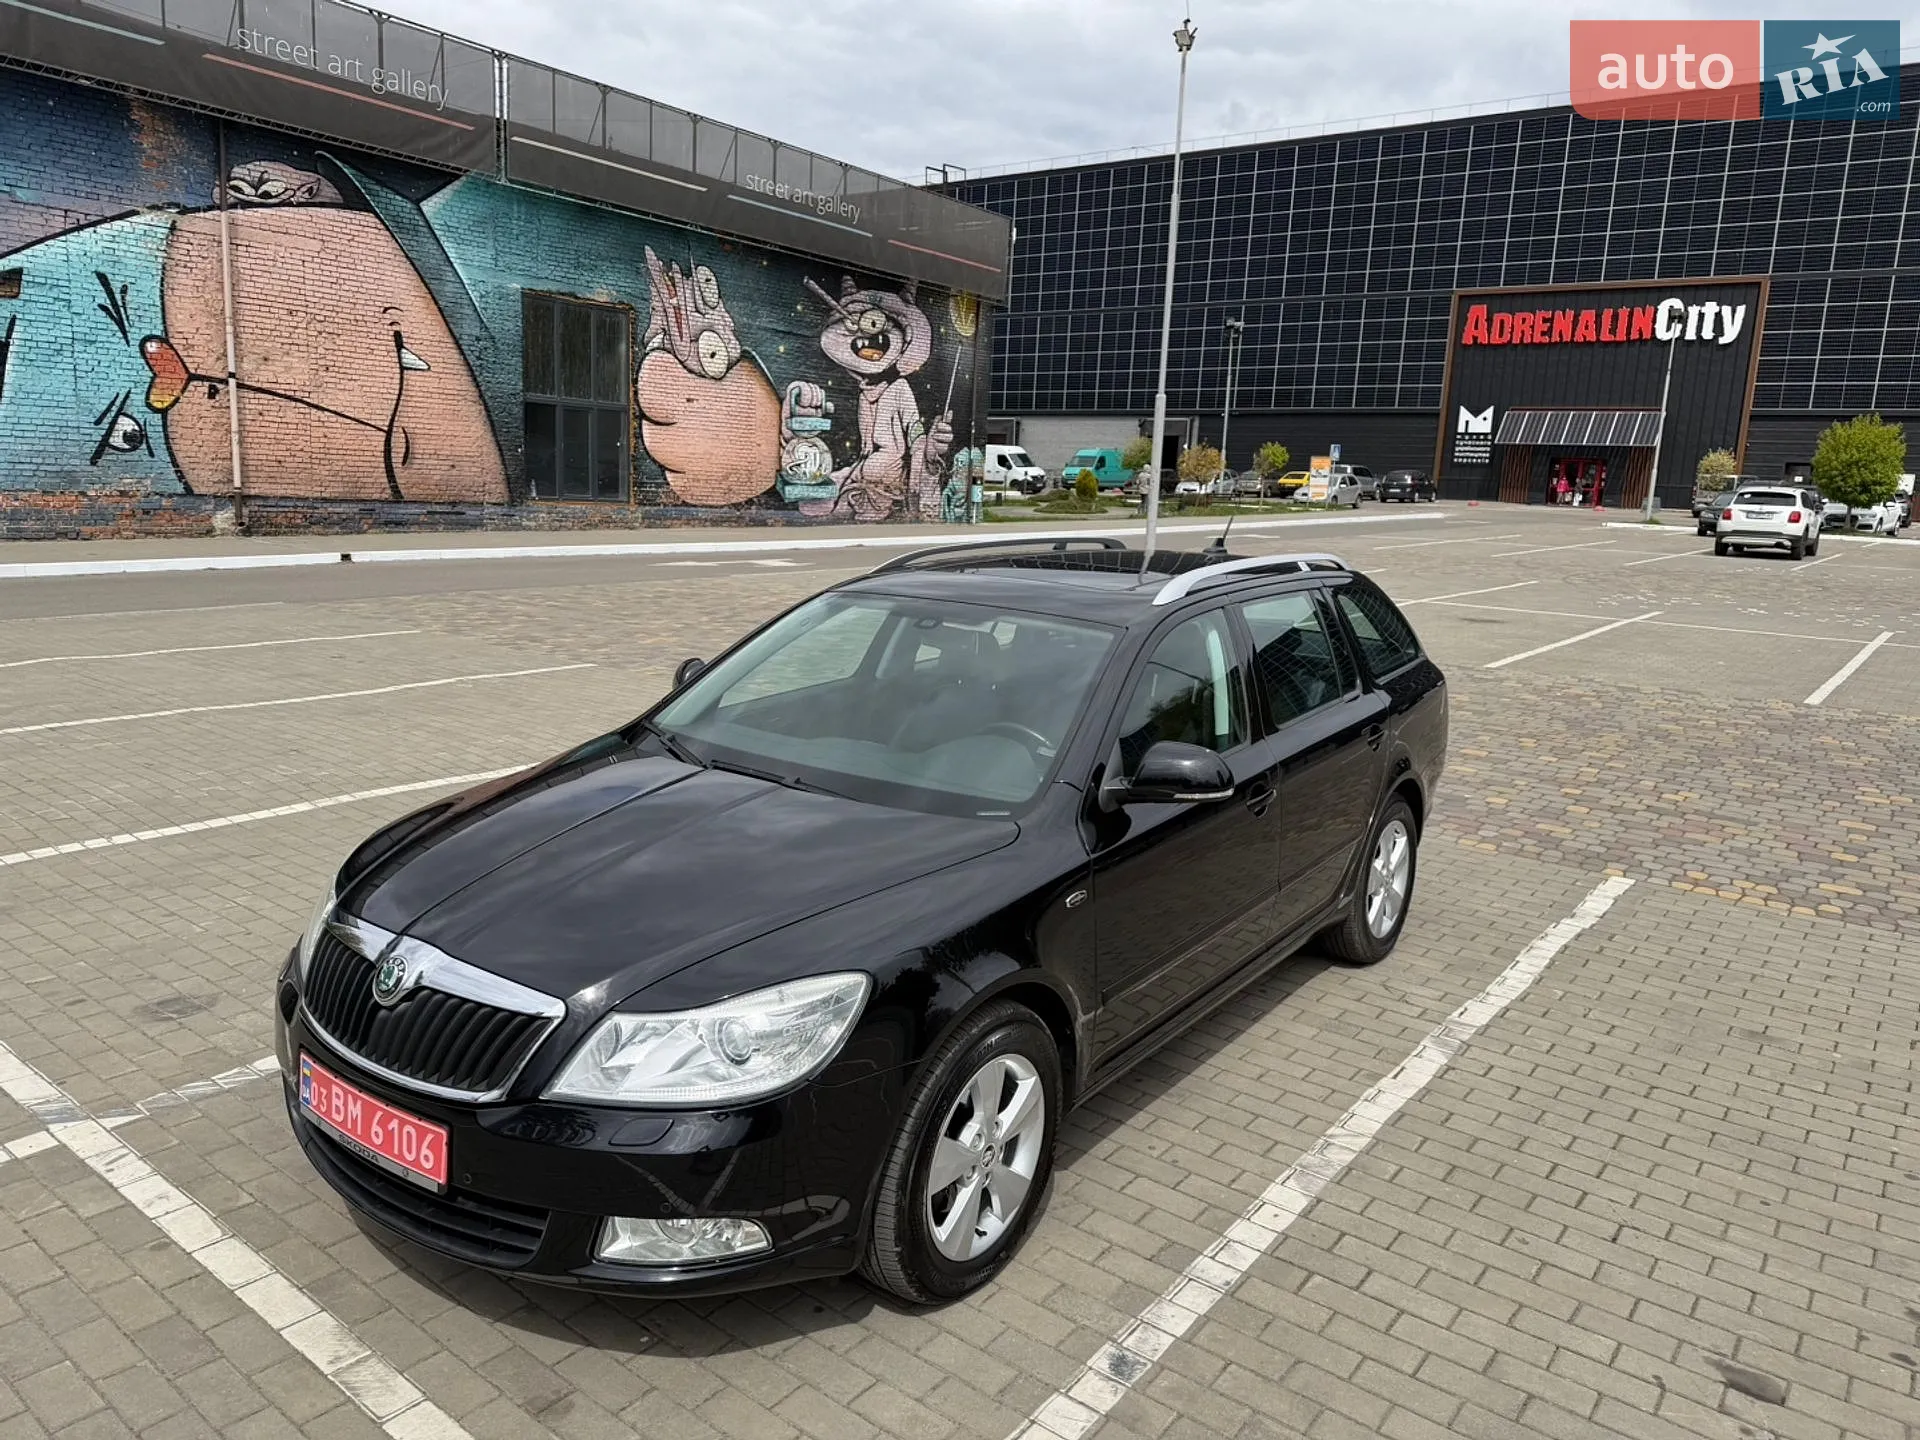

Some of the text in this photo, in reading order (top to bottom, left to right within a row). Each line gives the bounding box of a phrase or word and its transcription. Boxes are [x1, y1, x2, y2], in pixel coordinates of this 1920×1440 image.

[236, 28, 449, 111] street art gallery
[745, 174, 861, 225] street art gallery
[311, 1081, 327, 1113] 03
[331, 1083, 363, 1136] BM
[370, 1110, 436, 1170] 6106
